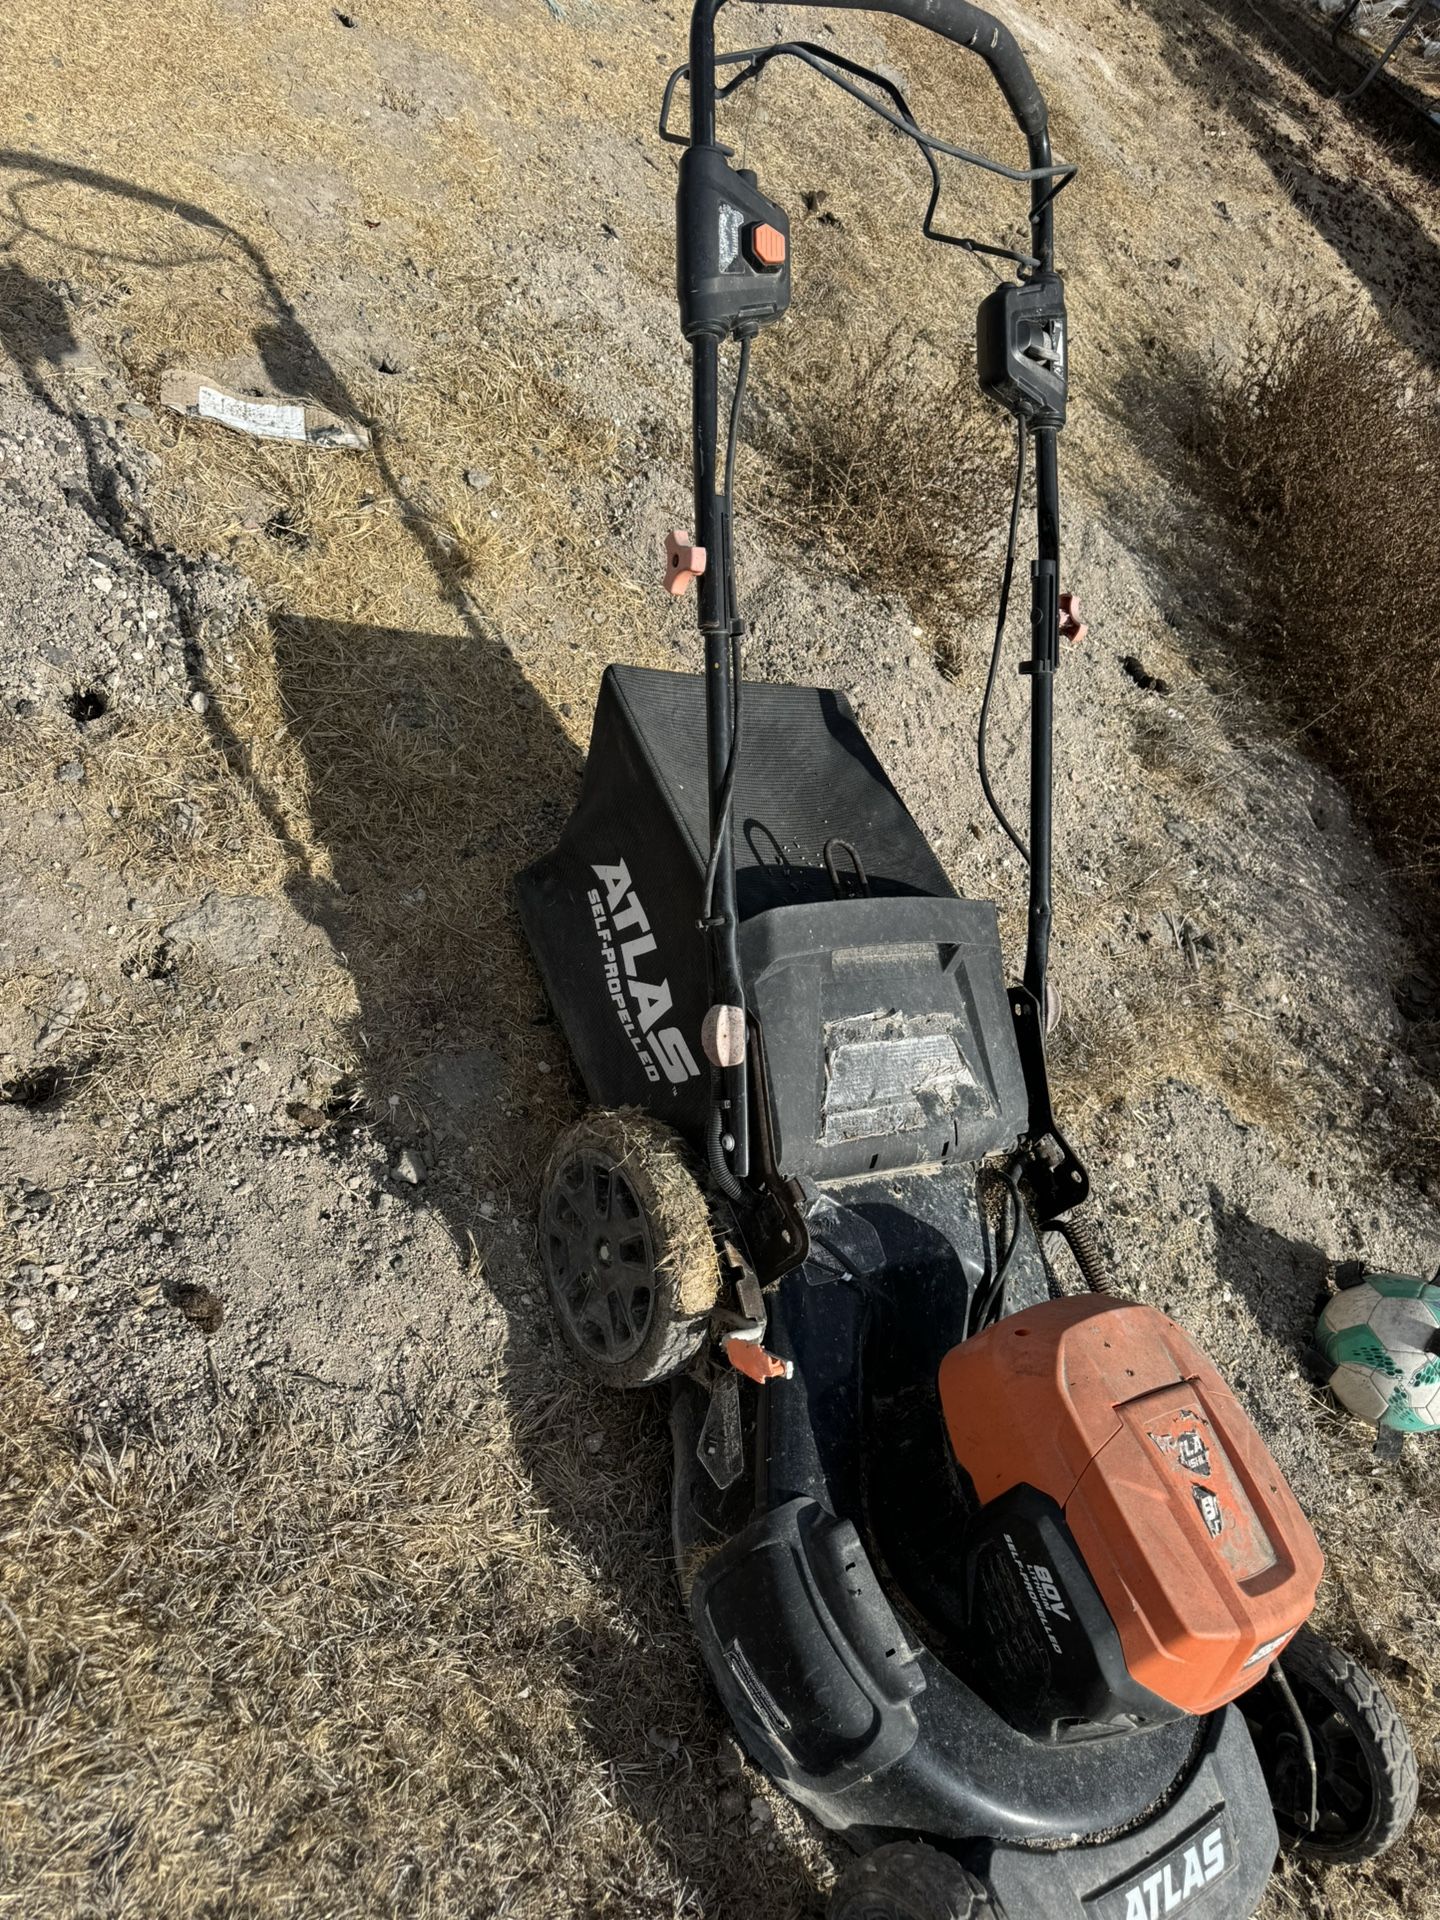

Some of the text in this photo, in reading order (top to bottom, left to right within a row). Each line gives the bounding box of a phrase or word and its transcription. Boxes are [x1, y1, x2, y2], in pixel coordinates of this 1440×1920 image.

[587, 888, 660, 1082] SELF-PROPELLED
[590, 857, 701, 1084] ATLAS
[1003, 1533, 1063, 1655] SELF-PROPELLED
[1026, 1564, 1052, 1612] LITHIUM
[1034, 1564, 1071, 1622] 80V
[1125, 1827, 1225, 1920] ATLAS
